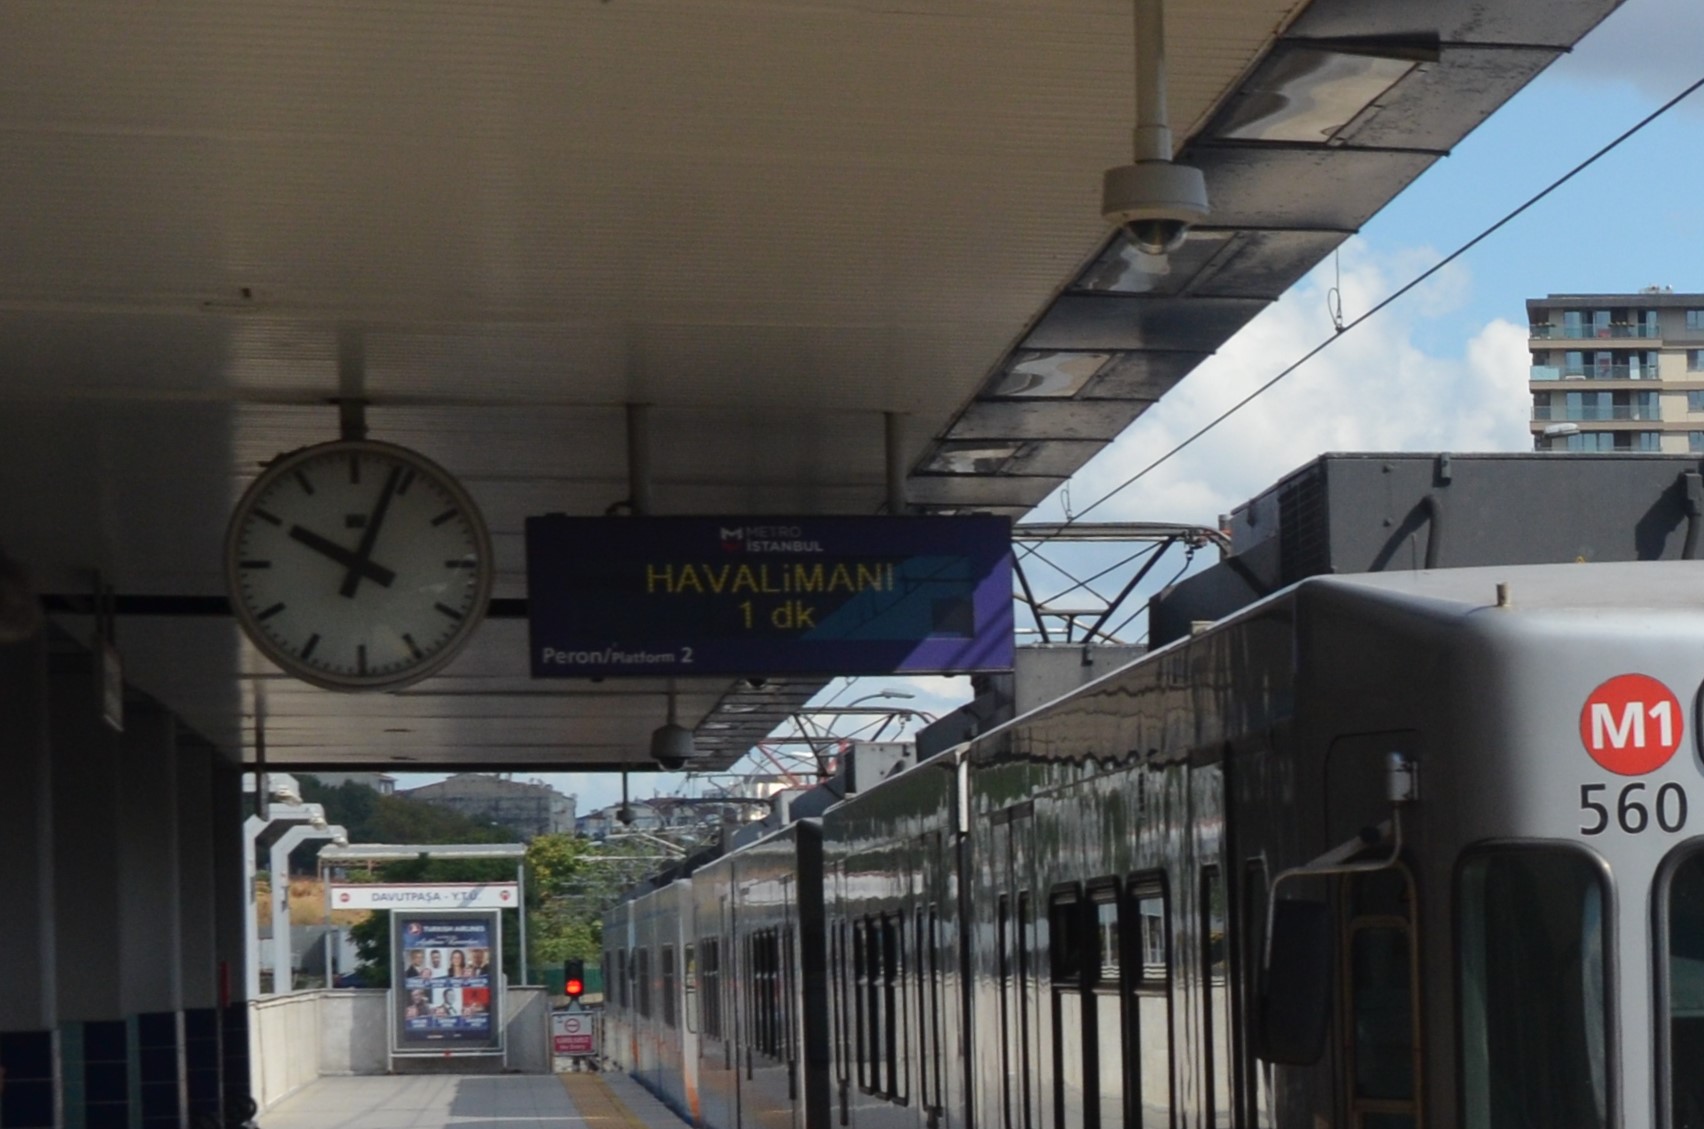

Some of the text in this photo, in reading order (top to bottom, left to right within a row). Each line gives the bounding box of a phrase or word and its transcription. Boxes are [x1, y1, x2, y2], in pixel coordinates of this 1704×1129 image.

[746, 525, 802, 538] METRO
[739, 601, 816, 629] 1 dk
[680, 646, 693, 664] 2
[1591, 700, 1672, 749] M1
[1580, 782, 1688, 835] 560
[371, 891, 440, 904] DAVUTPAŞA
